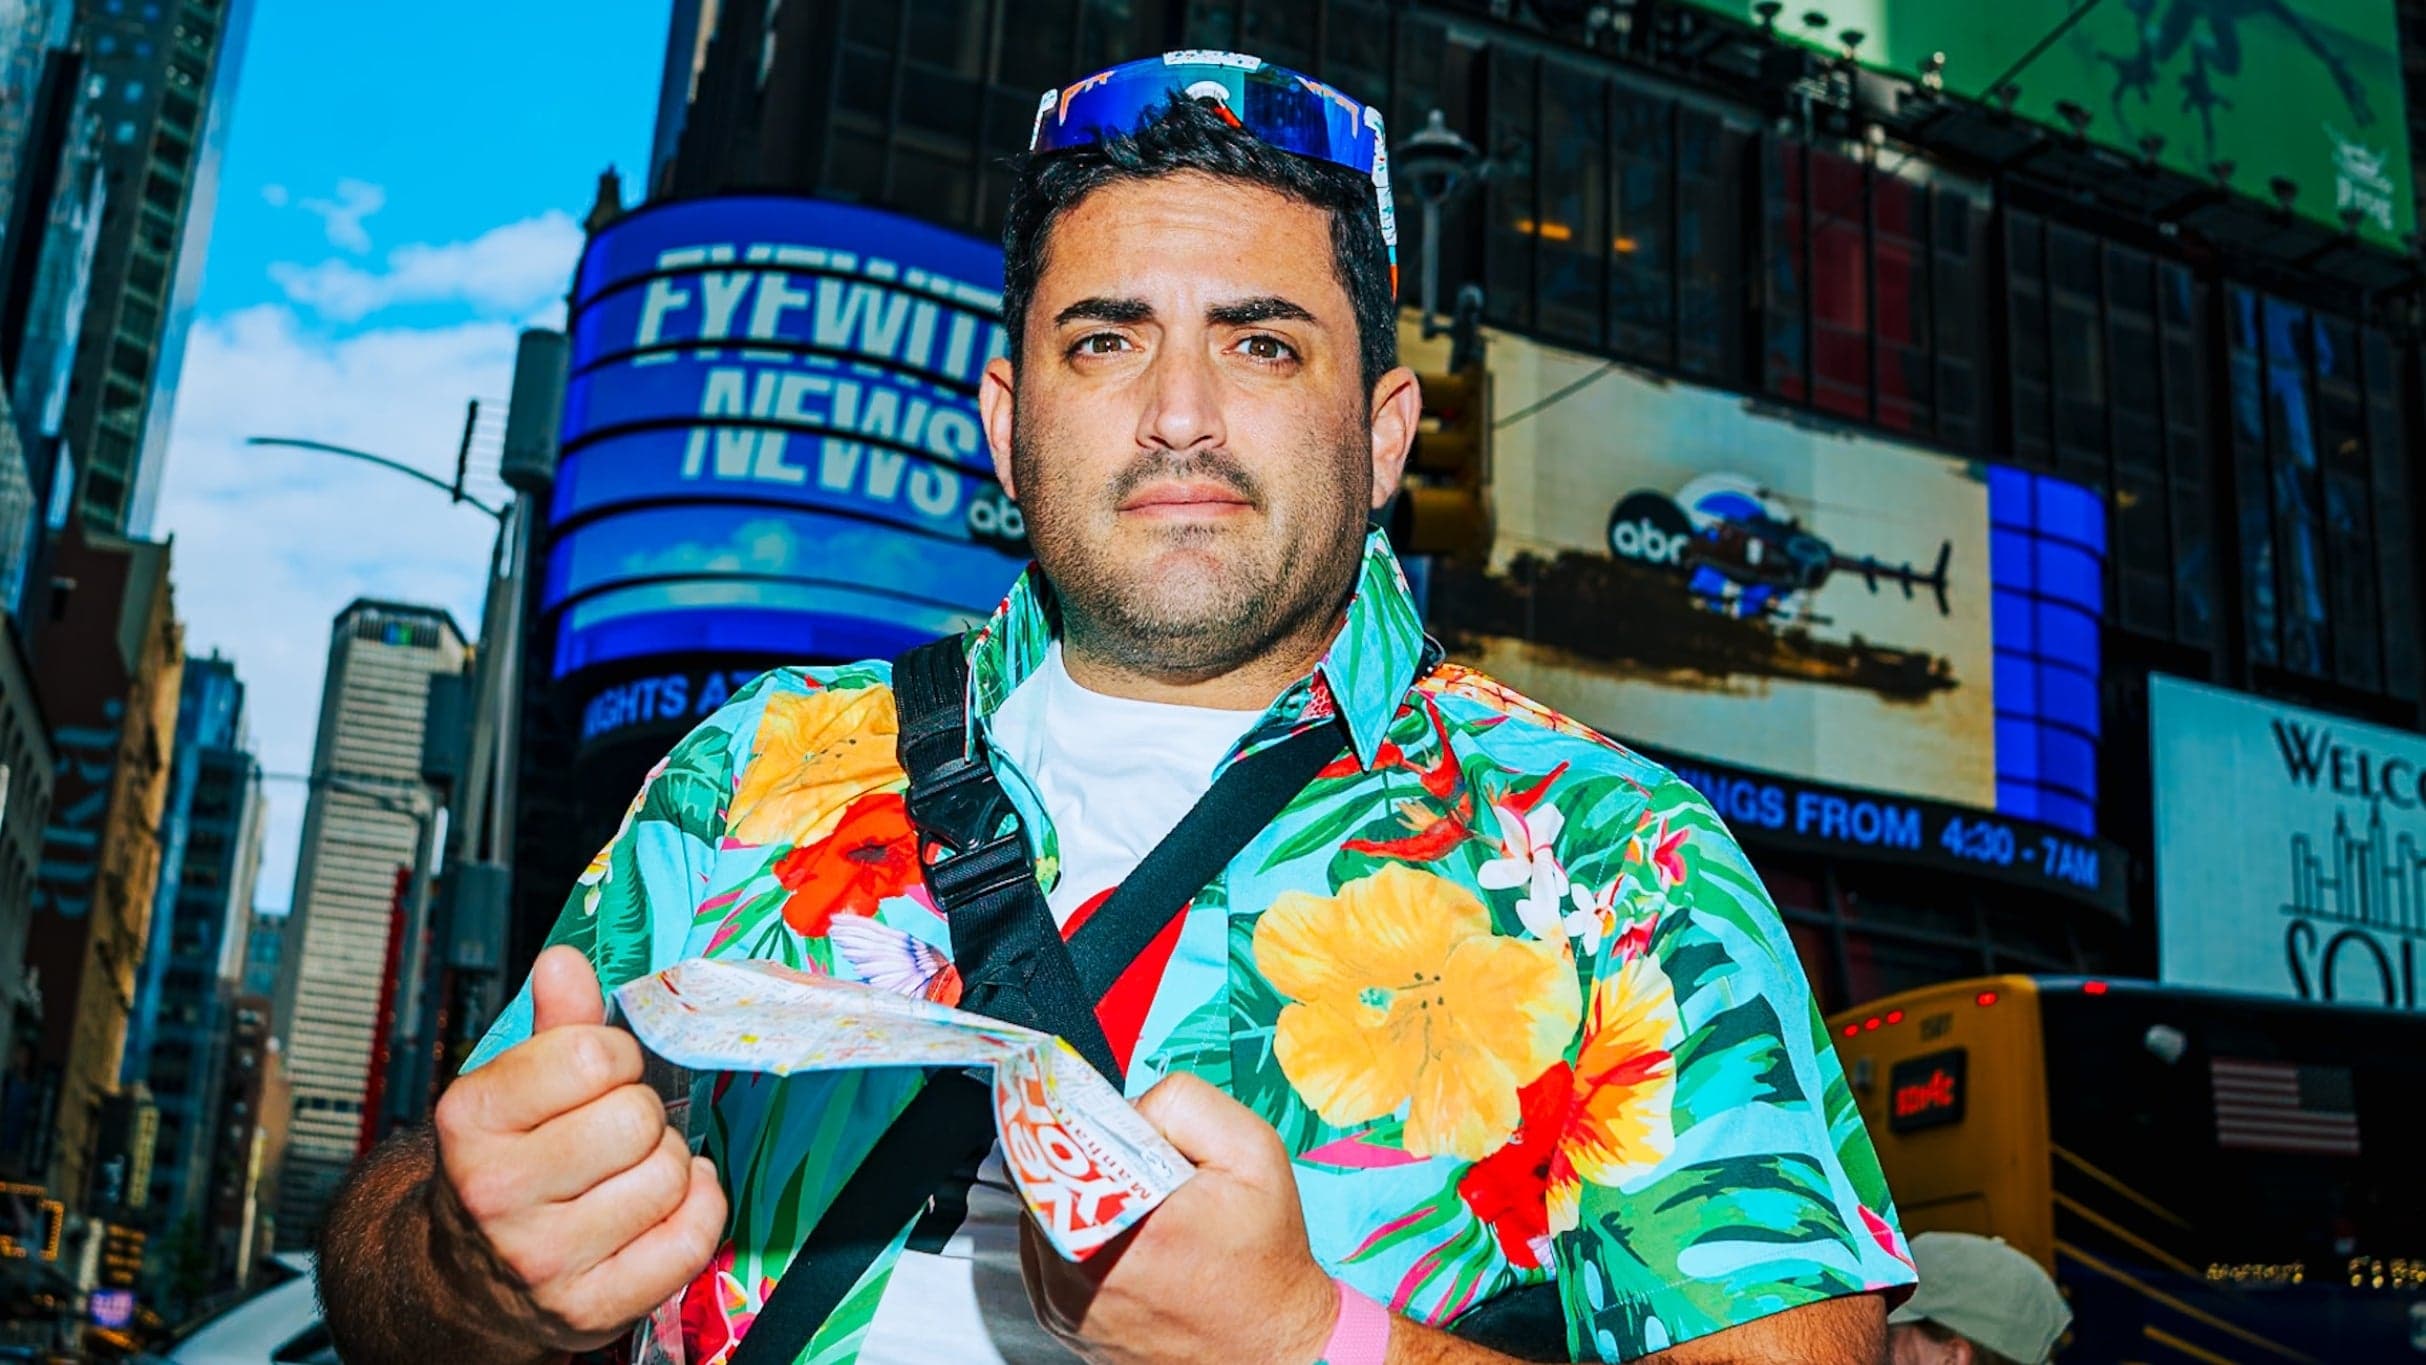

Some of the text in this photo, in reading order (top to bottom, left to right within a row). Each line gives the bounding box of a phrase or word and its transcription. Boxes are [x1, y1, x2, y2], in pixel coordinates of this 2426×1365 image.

[681, 367, 979, 519] NEWS
[2271, 717, 2426, 812] WELC
[1796, 793, 1922, 851] FROM
[1940, 817, 2015, 866] 4:30
[2041, 836, 2099, 889] 7AM
